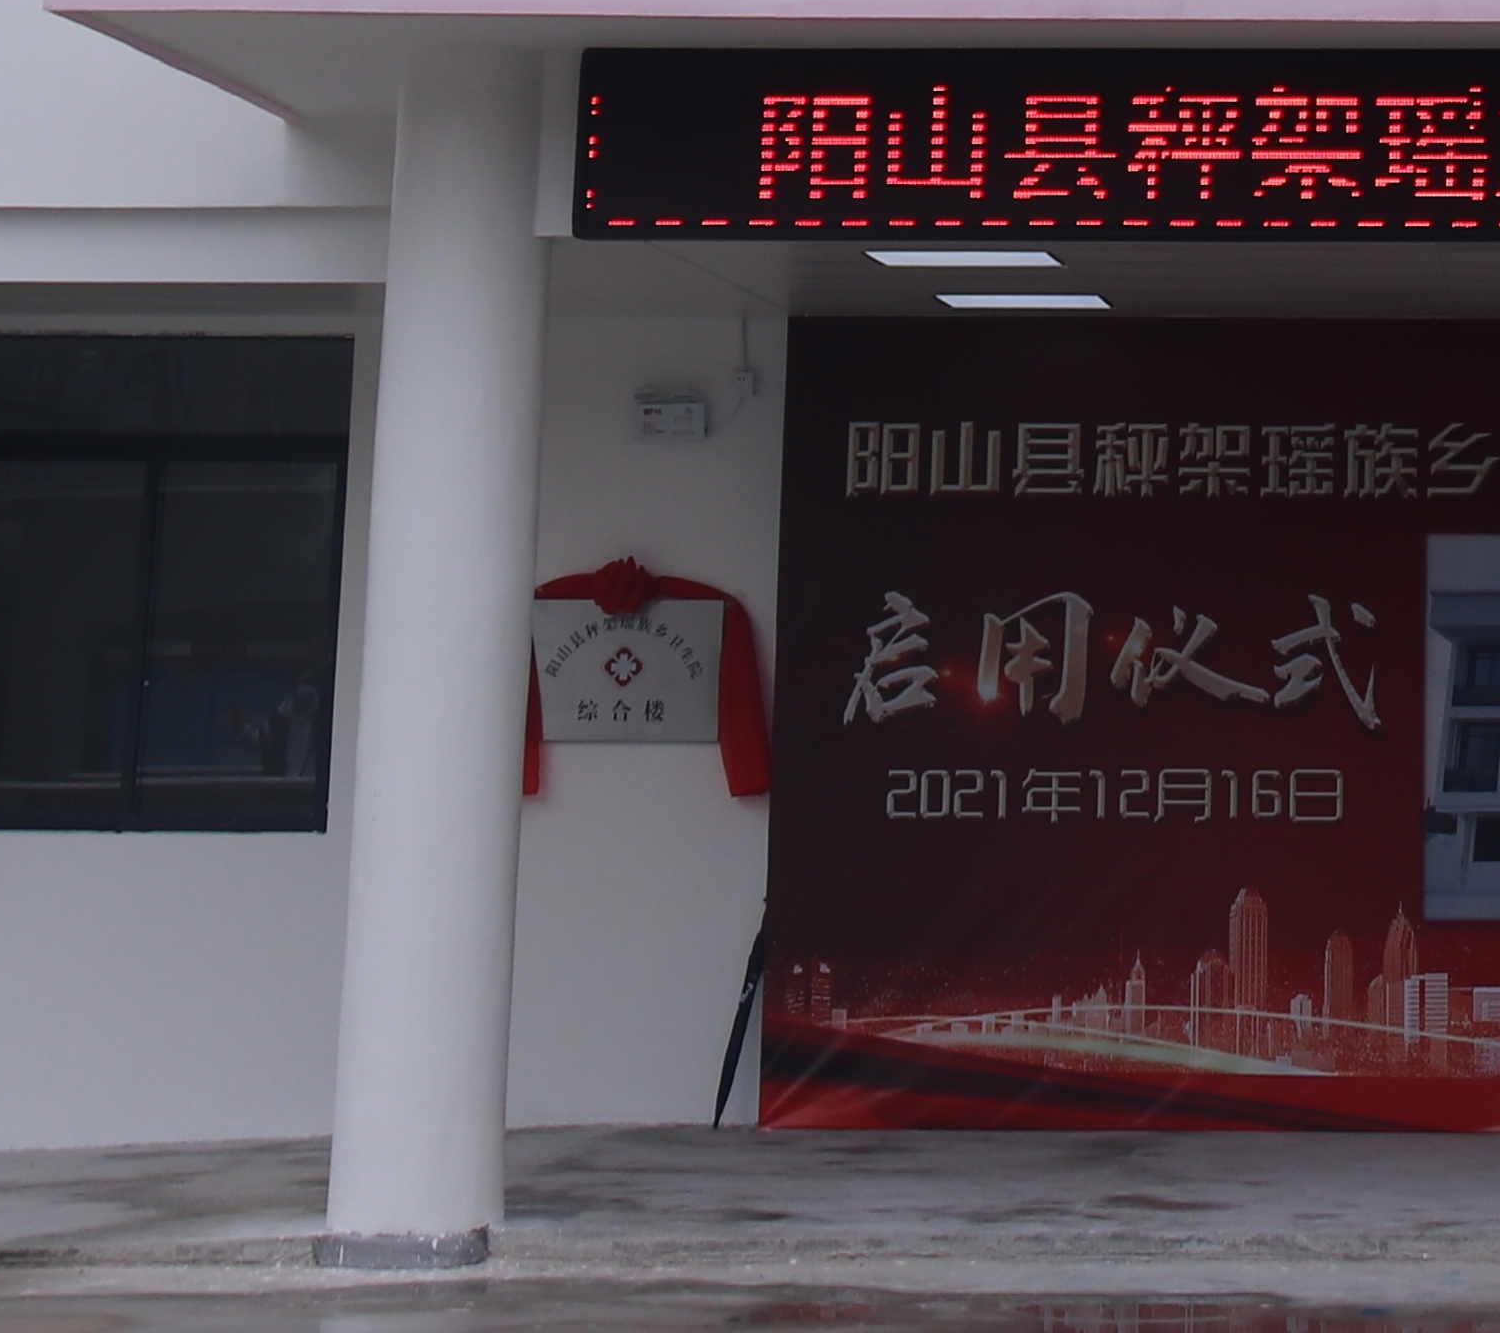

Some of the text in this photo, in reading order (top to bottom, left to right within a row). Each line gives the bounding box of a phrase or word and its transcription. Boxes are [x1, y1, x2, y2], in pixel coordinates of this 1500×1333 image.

[843, 590, 1381, 731] 启用仪式
[577, 699, 665, 722] 综合楼
[886, 768, 1343, 823] 2021年12月16日
